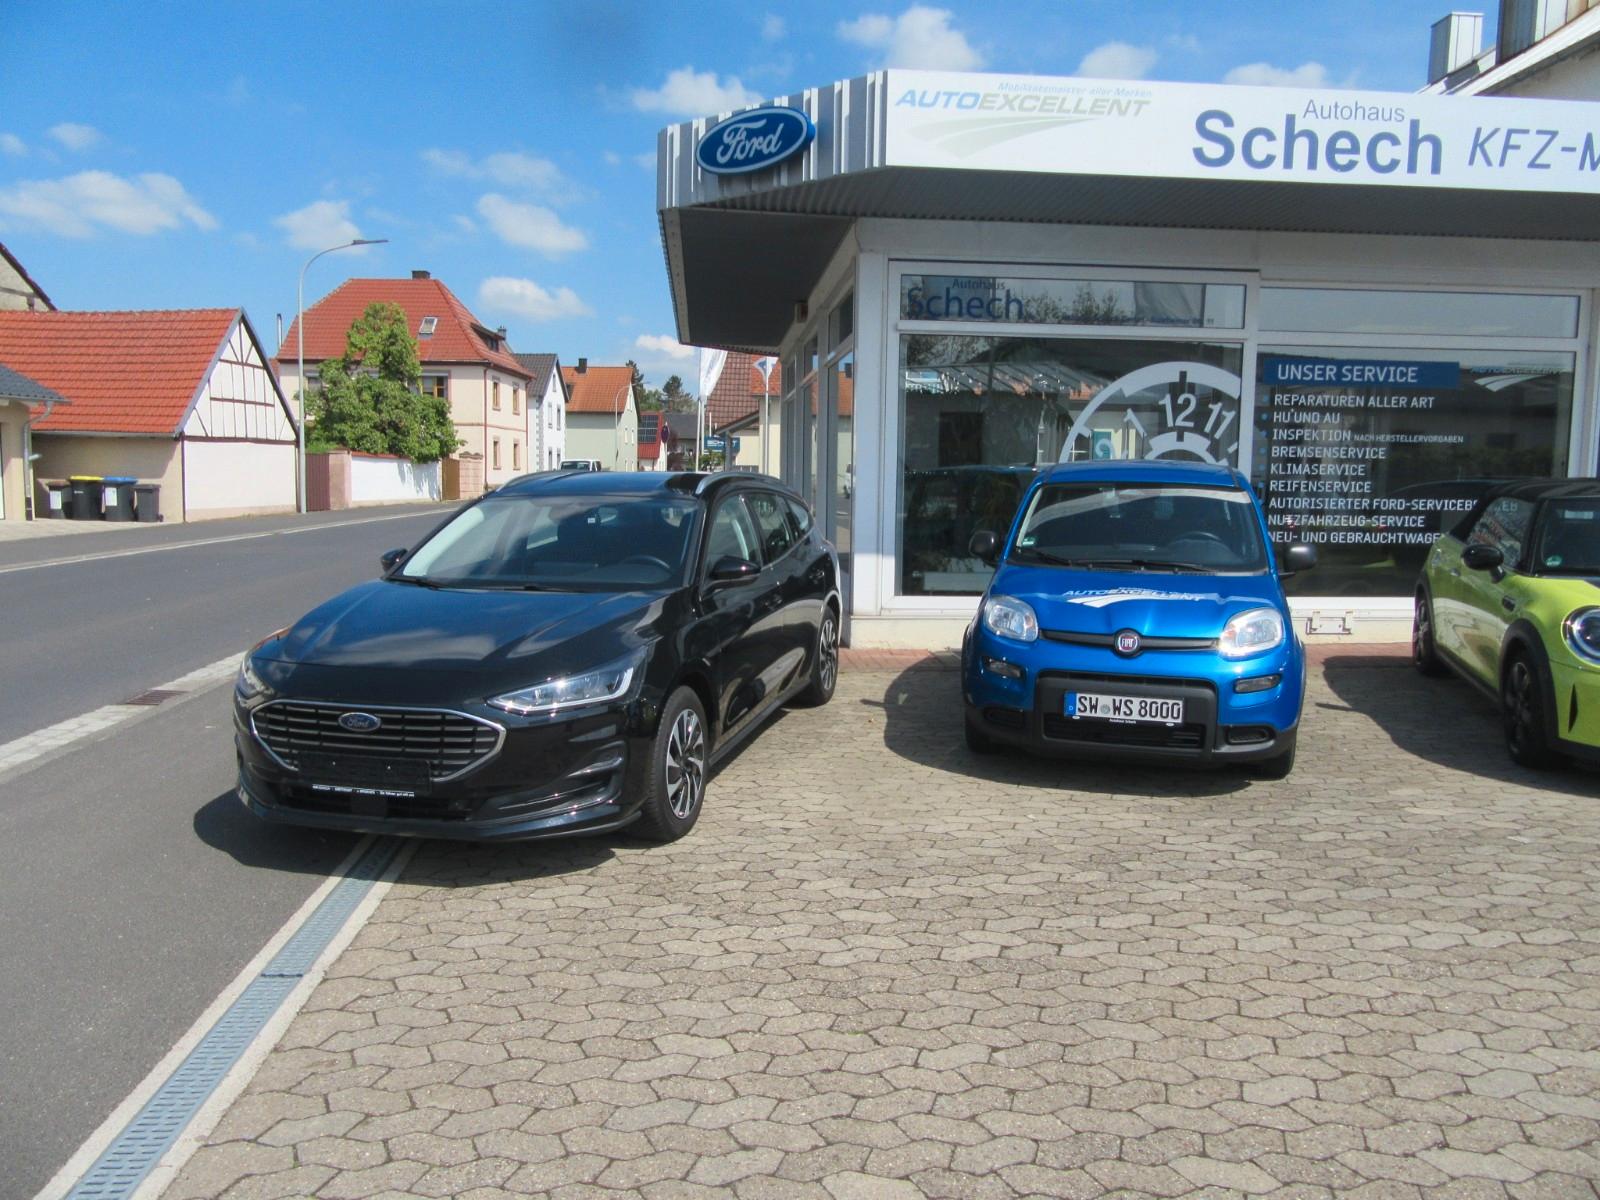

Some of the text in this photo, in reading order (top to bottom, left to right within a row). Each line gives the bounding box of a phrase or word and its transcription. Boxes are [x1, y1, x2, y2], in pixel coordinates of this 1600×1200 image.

[895, 89, 1152, 116] AUTOEXCELLENT
[1302, 99, 1406, 122] Autohaus
[716, 118, 785, 164] Ford
[1192, 109, 1443, 175] Schech
[908, 286, 1024, 319] Schech
[1277, 364, 1419, 383] UNSER SERVICE
[1274, 393, 1435, 409] REPARATUREN ALLER ART
[1159, 393, 1197, 428] 12
[1273, 411, 1341, 425] HU UND AU
[1272, 428, 1352, 442] INSPEKTION
[1271, 446, 1387, 459] BREMSENSERVICE
[1270, 463, 1366, 476] KLIMASERVICE
[1269, 480, 1372, 493] REIFENSERVICE
[1268, 496, 1370, 510] AUTORISIERTER
[1267, 513, 1425, 528] NUTZFAHRZEUG-SERVICE
[1301, 531, 1327, 543] UND
[1121, 638, 1134, 648] FIAT
[1077, 696, 1099, 714] SW
[1112, 698, 1134, 717] WS
[1138, 700, 1181, 720] 8000
